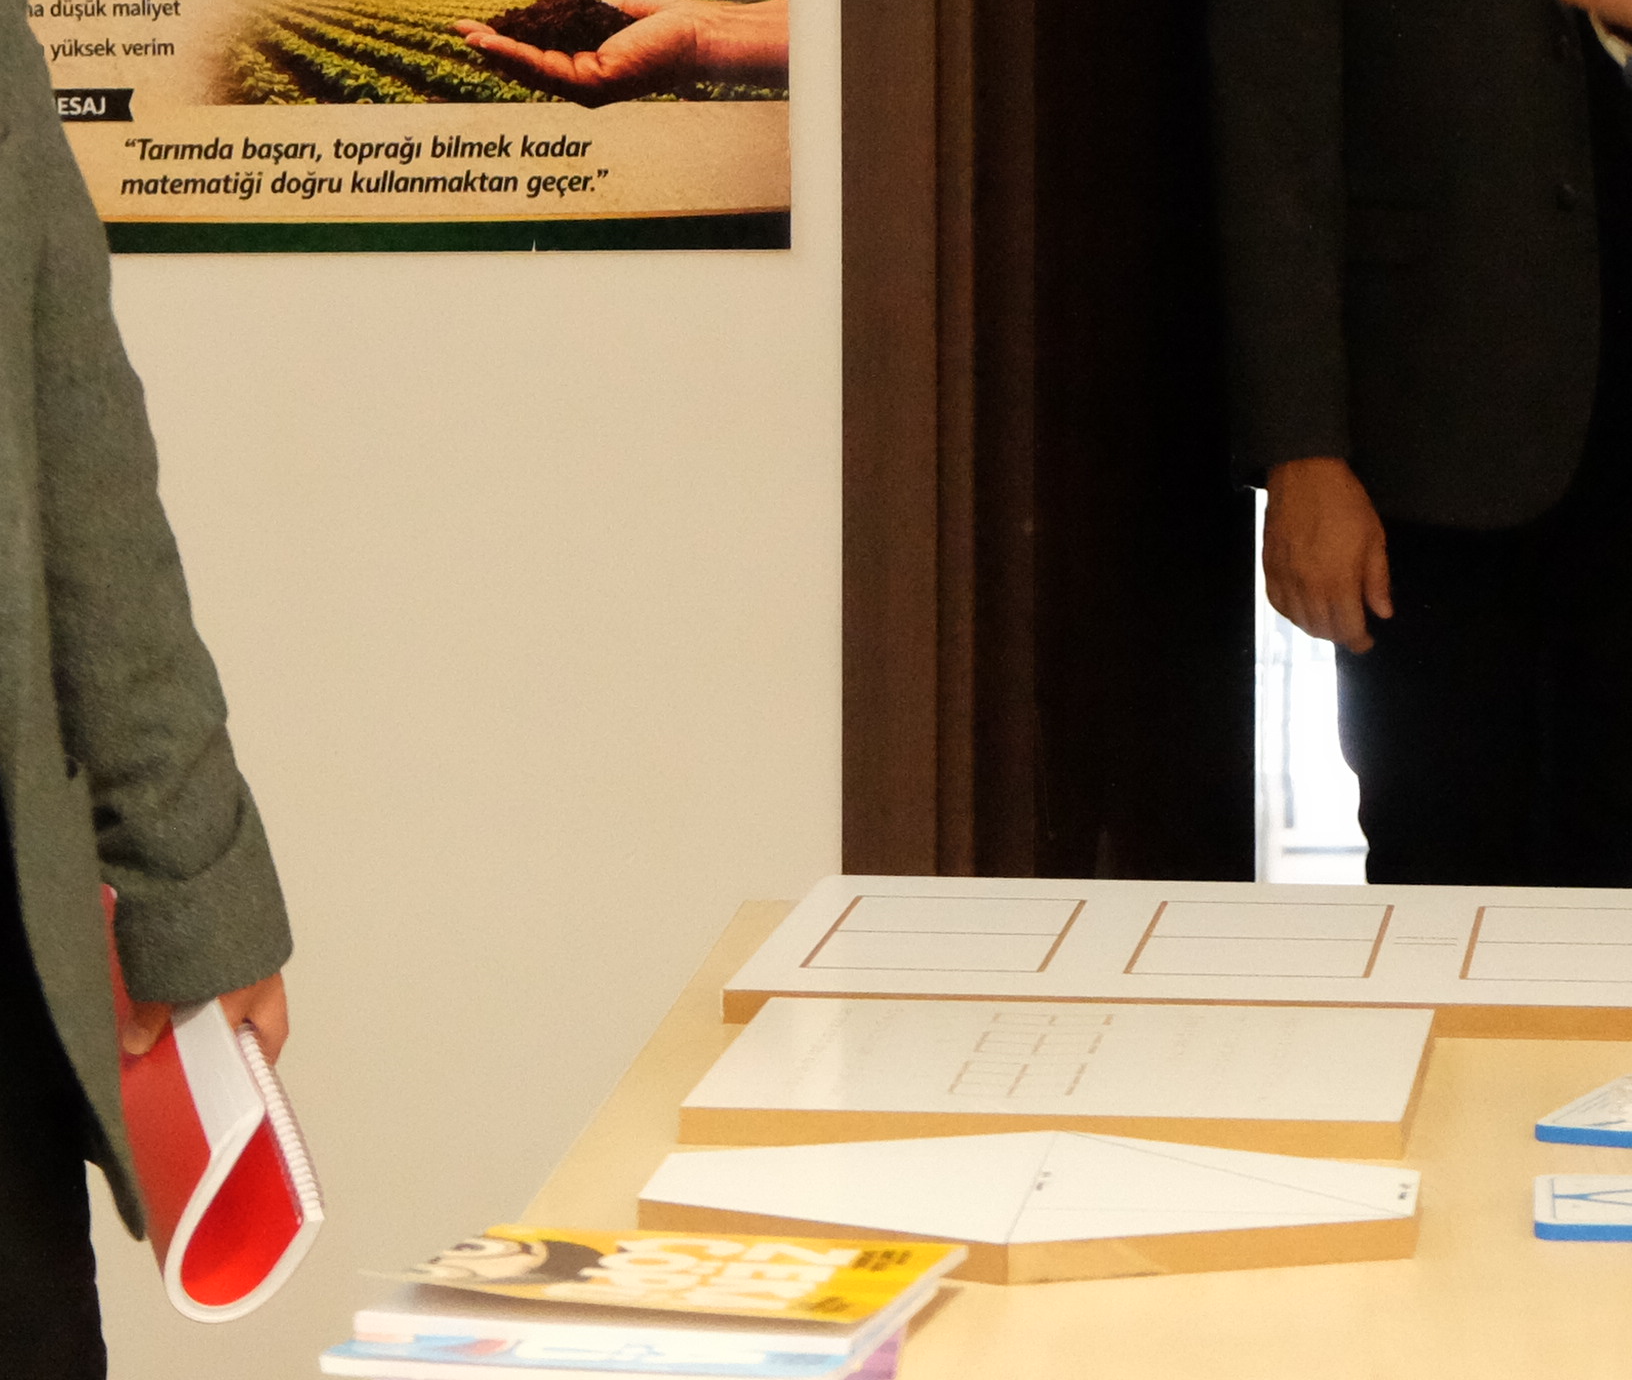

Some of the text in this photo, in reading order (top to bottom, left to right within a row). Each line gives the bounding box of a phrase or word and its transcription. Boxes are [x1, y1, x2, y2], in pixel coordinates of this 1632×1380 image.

[50, 0, 107, 21] düşük
[50, 38, 174, 61] yüksek verim
[125, 134, 592, 165] “Tarımda başarı, toprağı bilmek kadar
[121, 169, 609, 200] matematiği doğru kullanmaktan geçer.”
